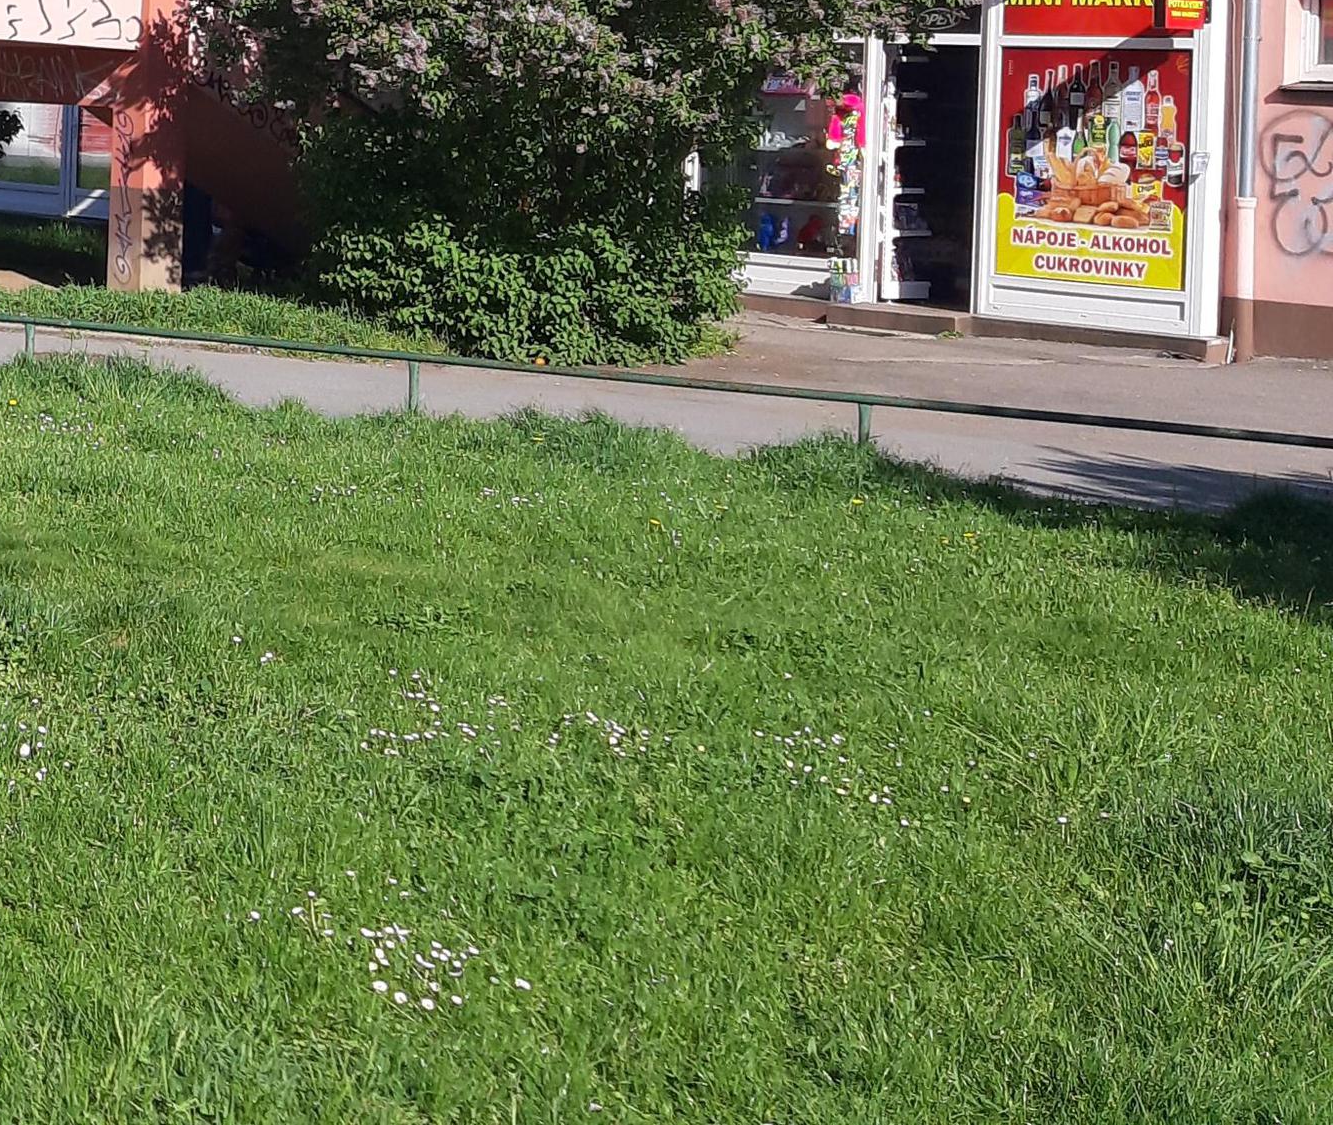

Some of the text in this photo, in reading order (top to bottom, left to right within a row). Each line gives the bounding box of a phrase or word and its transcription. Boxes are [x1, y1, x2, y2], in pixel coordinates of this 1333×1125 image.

[1012, 226, 1077, 248] NÁPOJE
[1090, 234, 1172, 256] ALKOHOL
[1034, 255, 1147, 279] CUKROVINKY
